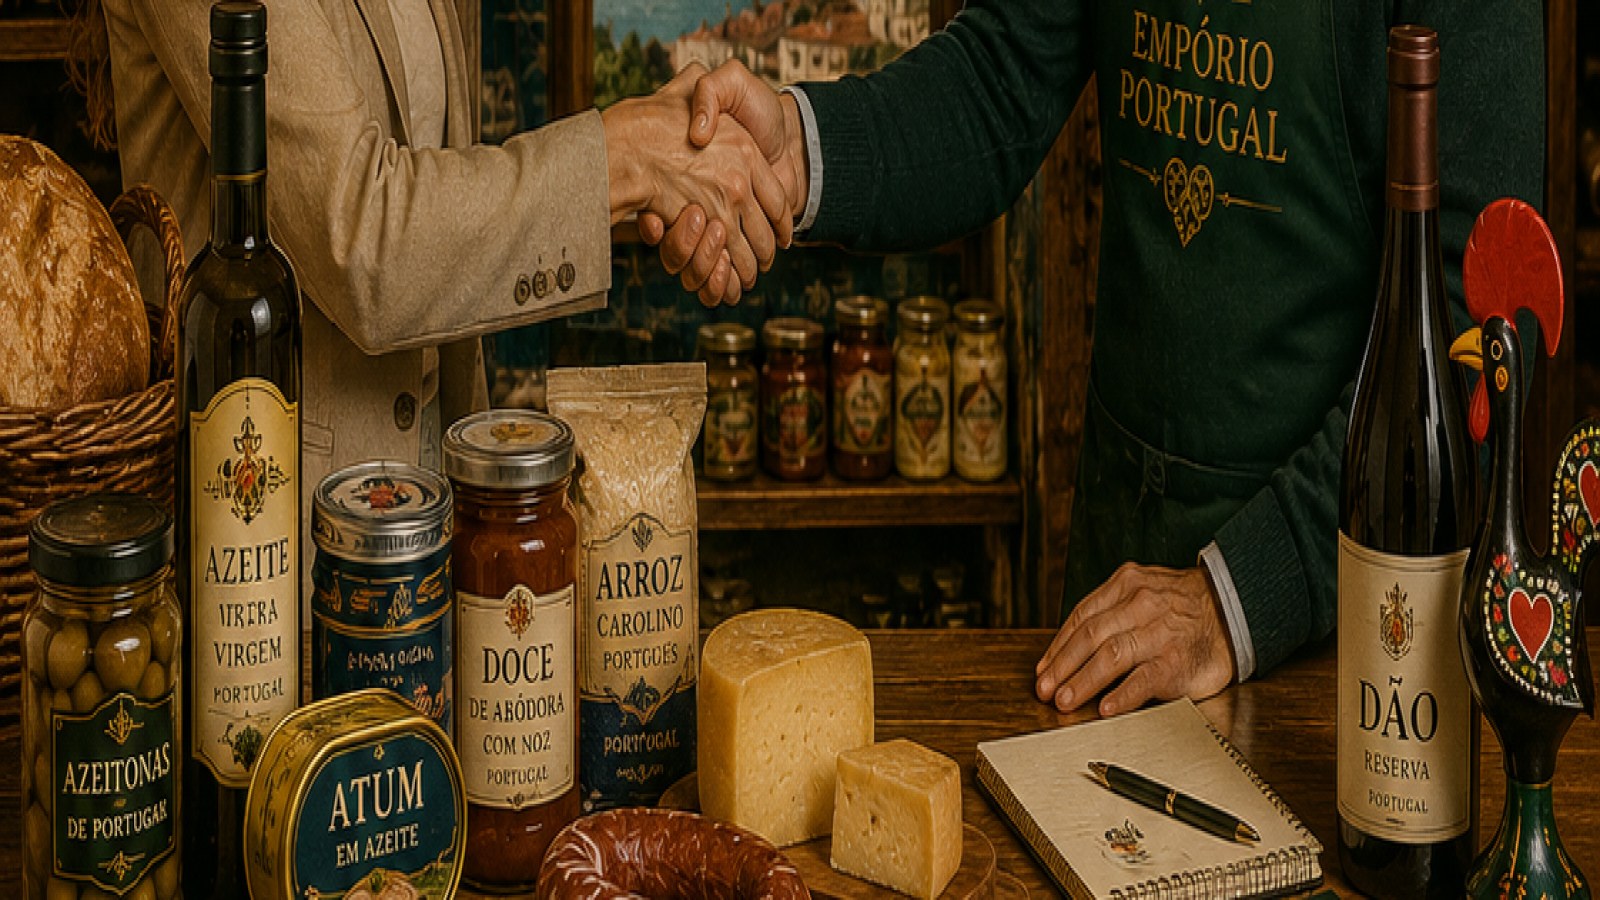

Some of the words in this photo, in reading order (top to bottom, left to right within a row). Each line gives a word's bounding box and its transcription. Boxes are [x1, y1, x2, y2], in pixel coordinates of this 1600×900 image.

[1132, 10, 1274, 91] EMPÓRIO
[1119, 68, 1287, 163] PORTUGAL
[205, 537, 289, 584] AZEITE
[596, 555, 684, 600] ARROZ
[597, 604, 684, 637] CAROLINO
[213, 636, 282, 667] VIRGEM
[482, 643, 554, 685] DOCE
[469, 697, 488, 720] DE
[1359, 675, 1438, 742] DÃO
[483, 734, 517, 755] COM
[1364, 749, 1430, 779] RESERVA
[62, 741, 170, 795] AZEITONAS
[328, 759, 424, 832] ATUM
[67, 816, 88, 839] DE
[336, 840, 359, 868] EM
[364, 823, 419, 861] AZEITE
